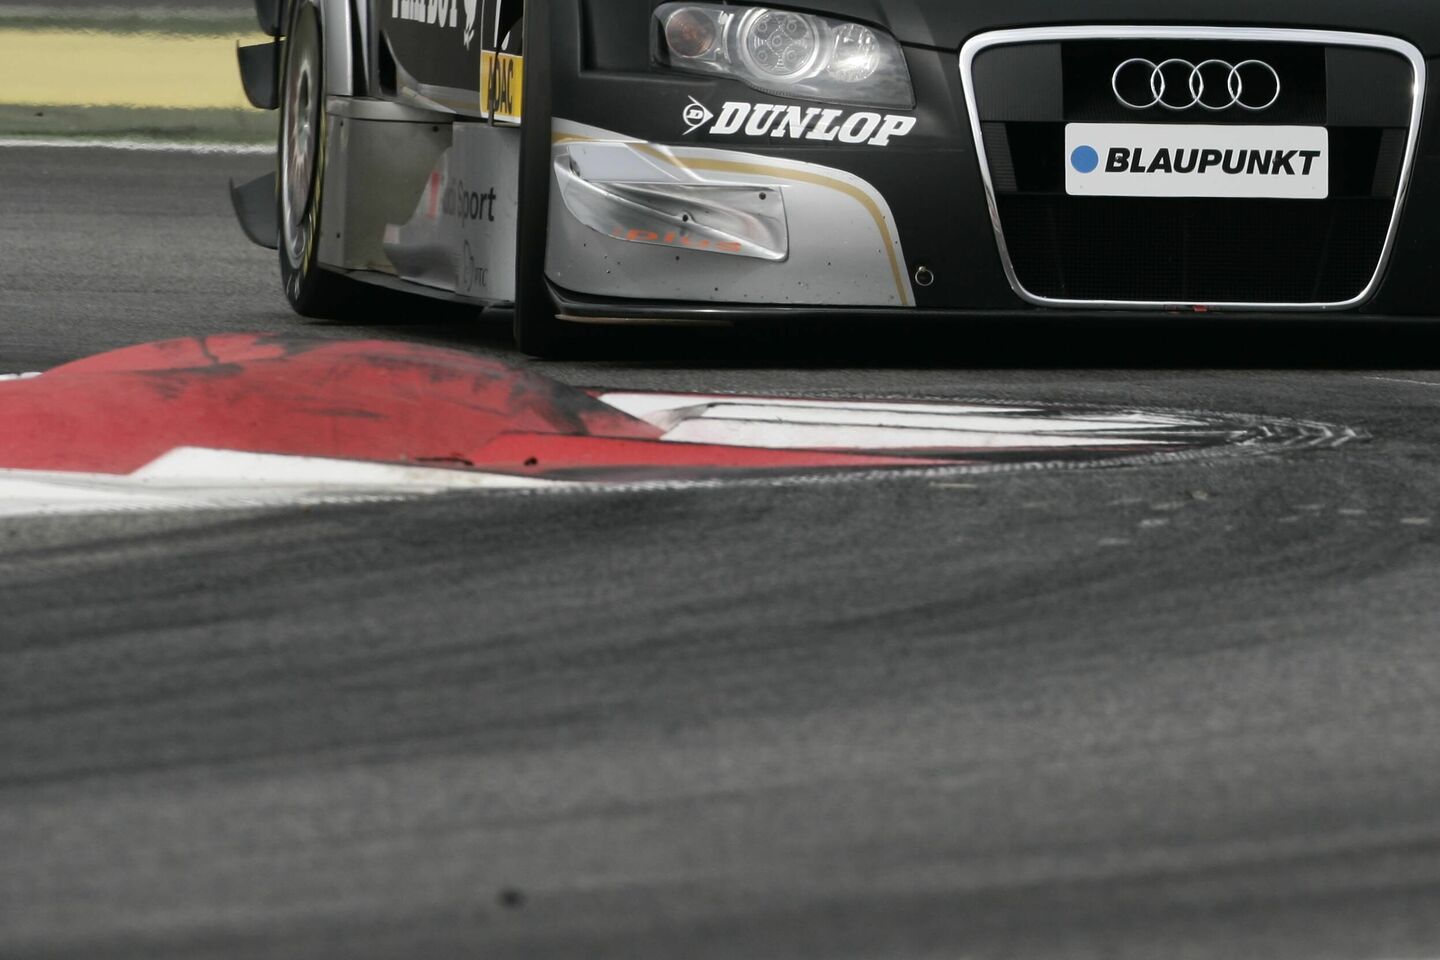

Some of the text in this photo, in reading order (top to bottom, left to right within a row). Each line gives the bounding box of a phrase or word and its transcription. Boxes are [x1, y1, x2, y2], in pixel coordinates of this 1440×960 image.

[487, 56, 514, 114] ADAC
[709, 101, 916, 146] DUNLOP
[1105, 147, 1321, 175] BLAUPUNKT
